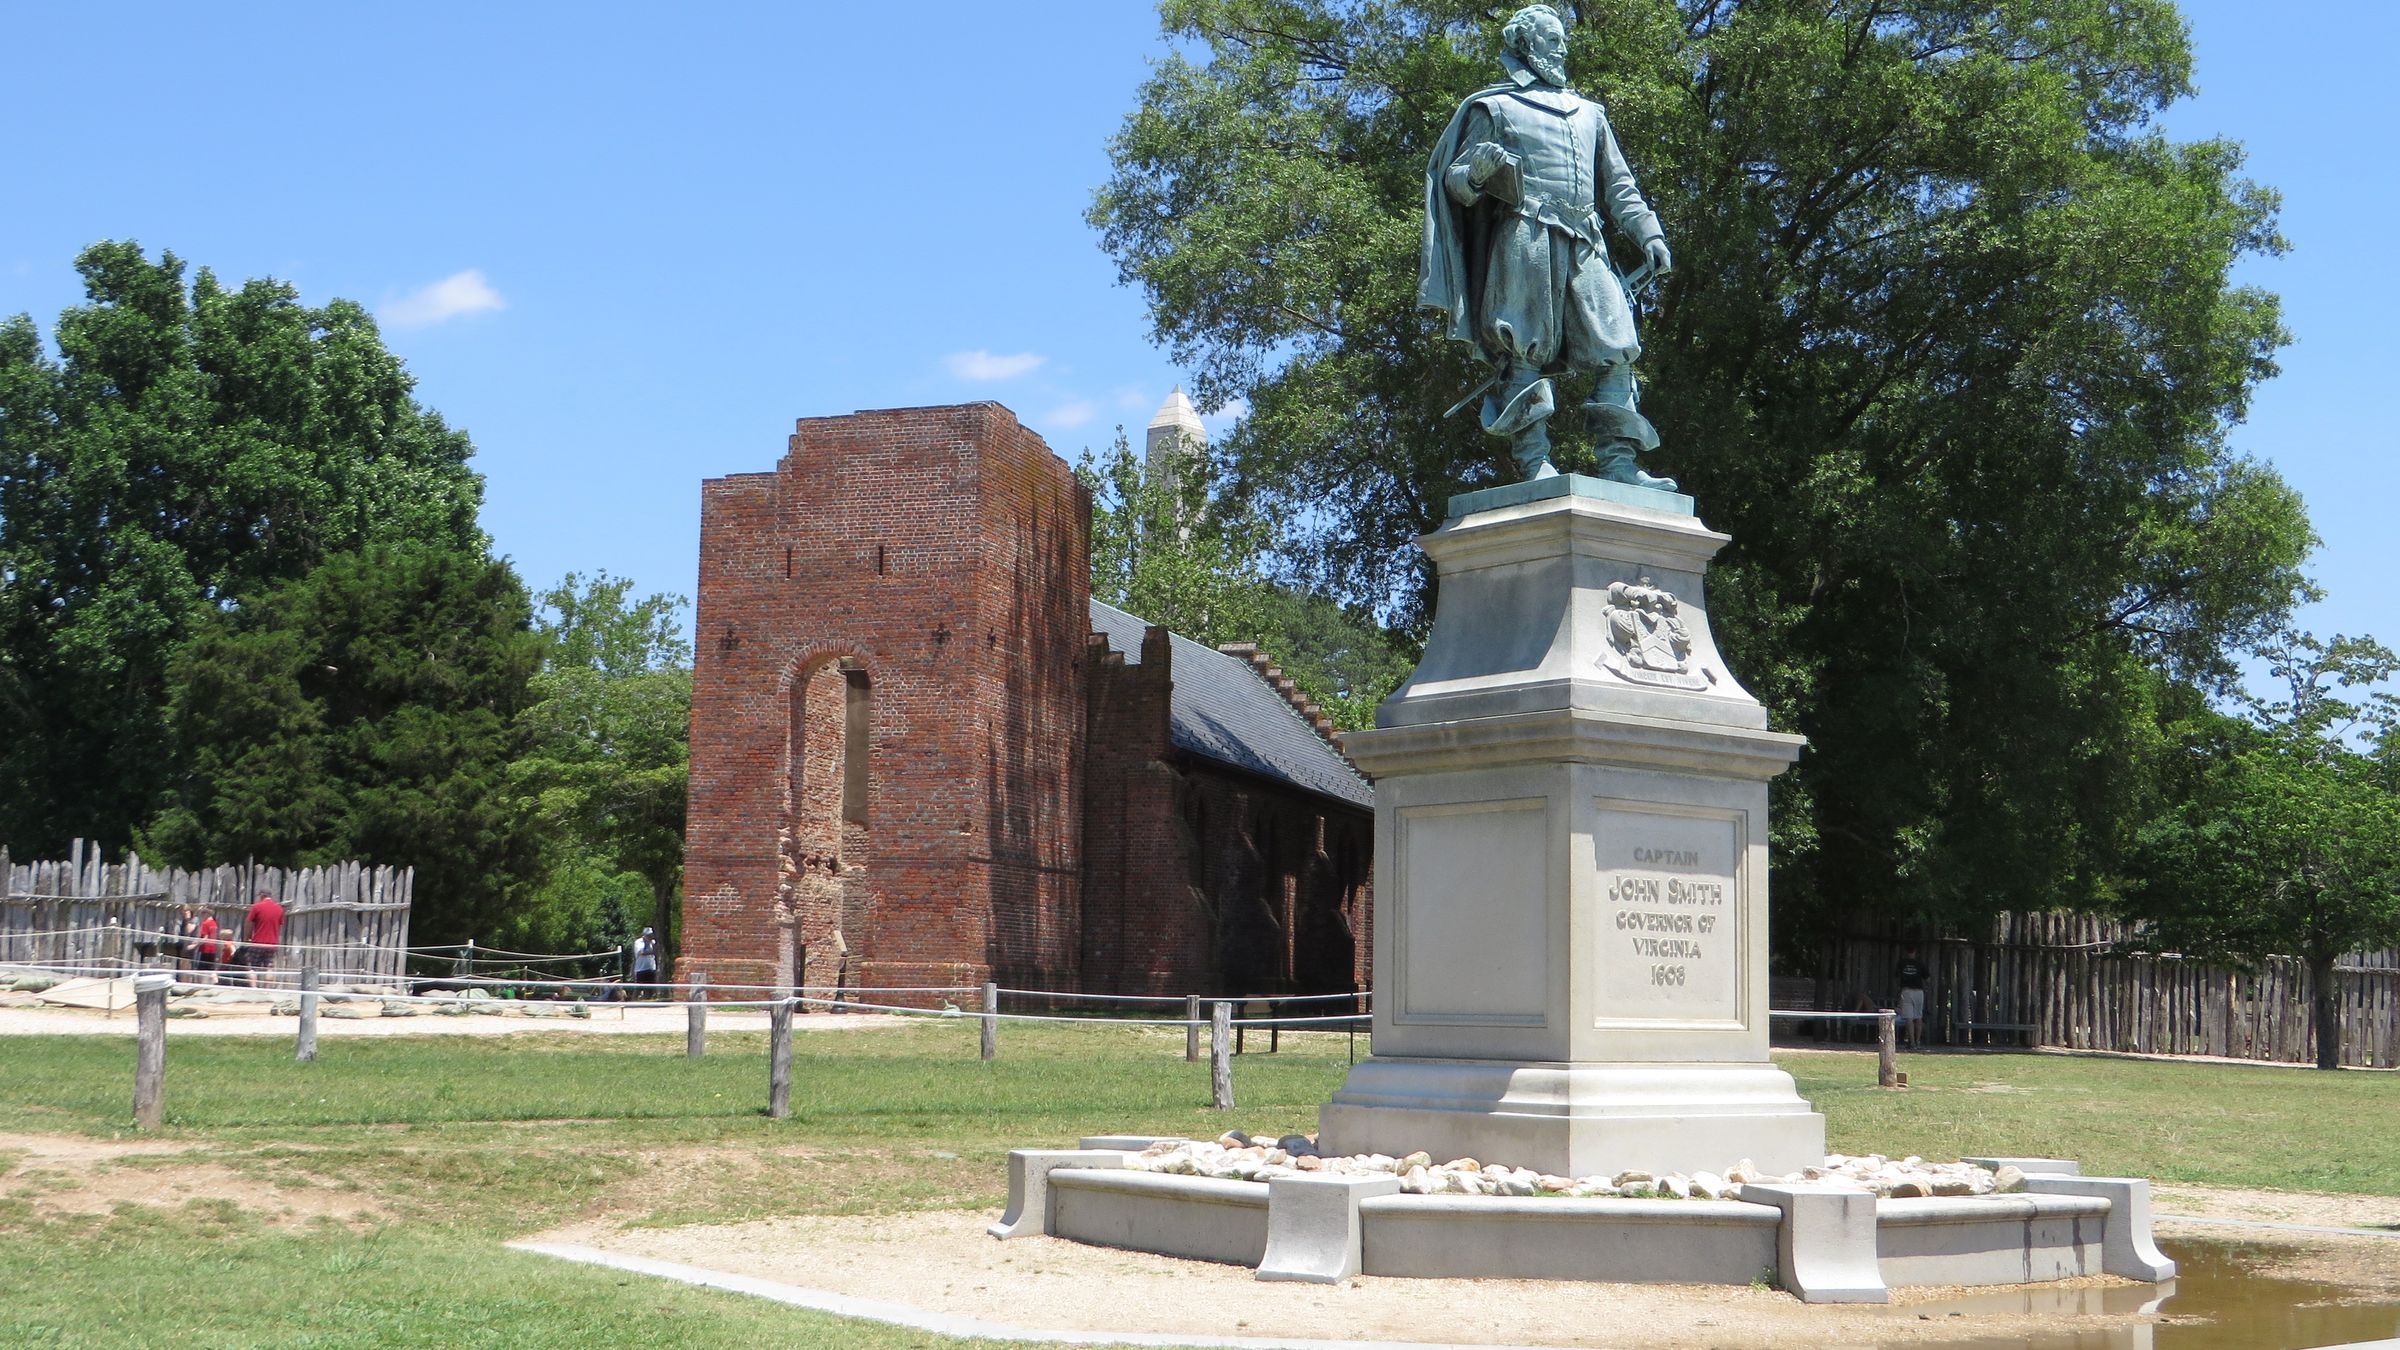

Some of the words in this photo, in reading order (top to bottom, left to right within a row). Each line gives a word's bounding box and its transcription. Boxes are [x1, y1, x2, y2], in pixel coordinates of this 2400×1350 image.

[1633, 848, 1698, 866] CAPTAIN
[1609, 875, 1660, 904] JOHN
[1668, 877, 1722, 905] SMITH
[1616, 910, 1693, 933] GOVERNOR
[1698, 914, 1716, 933] OF
[1632, 937, 1702, 959] VIRGINIA
[1651, 964, 1686, 986] 1608
